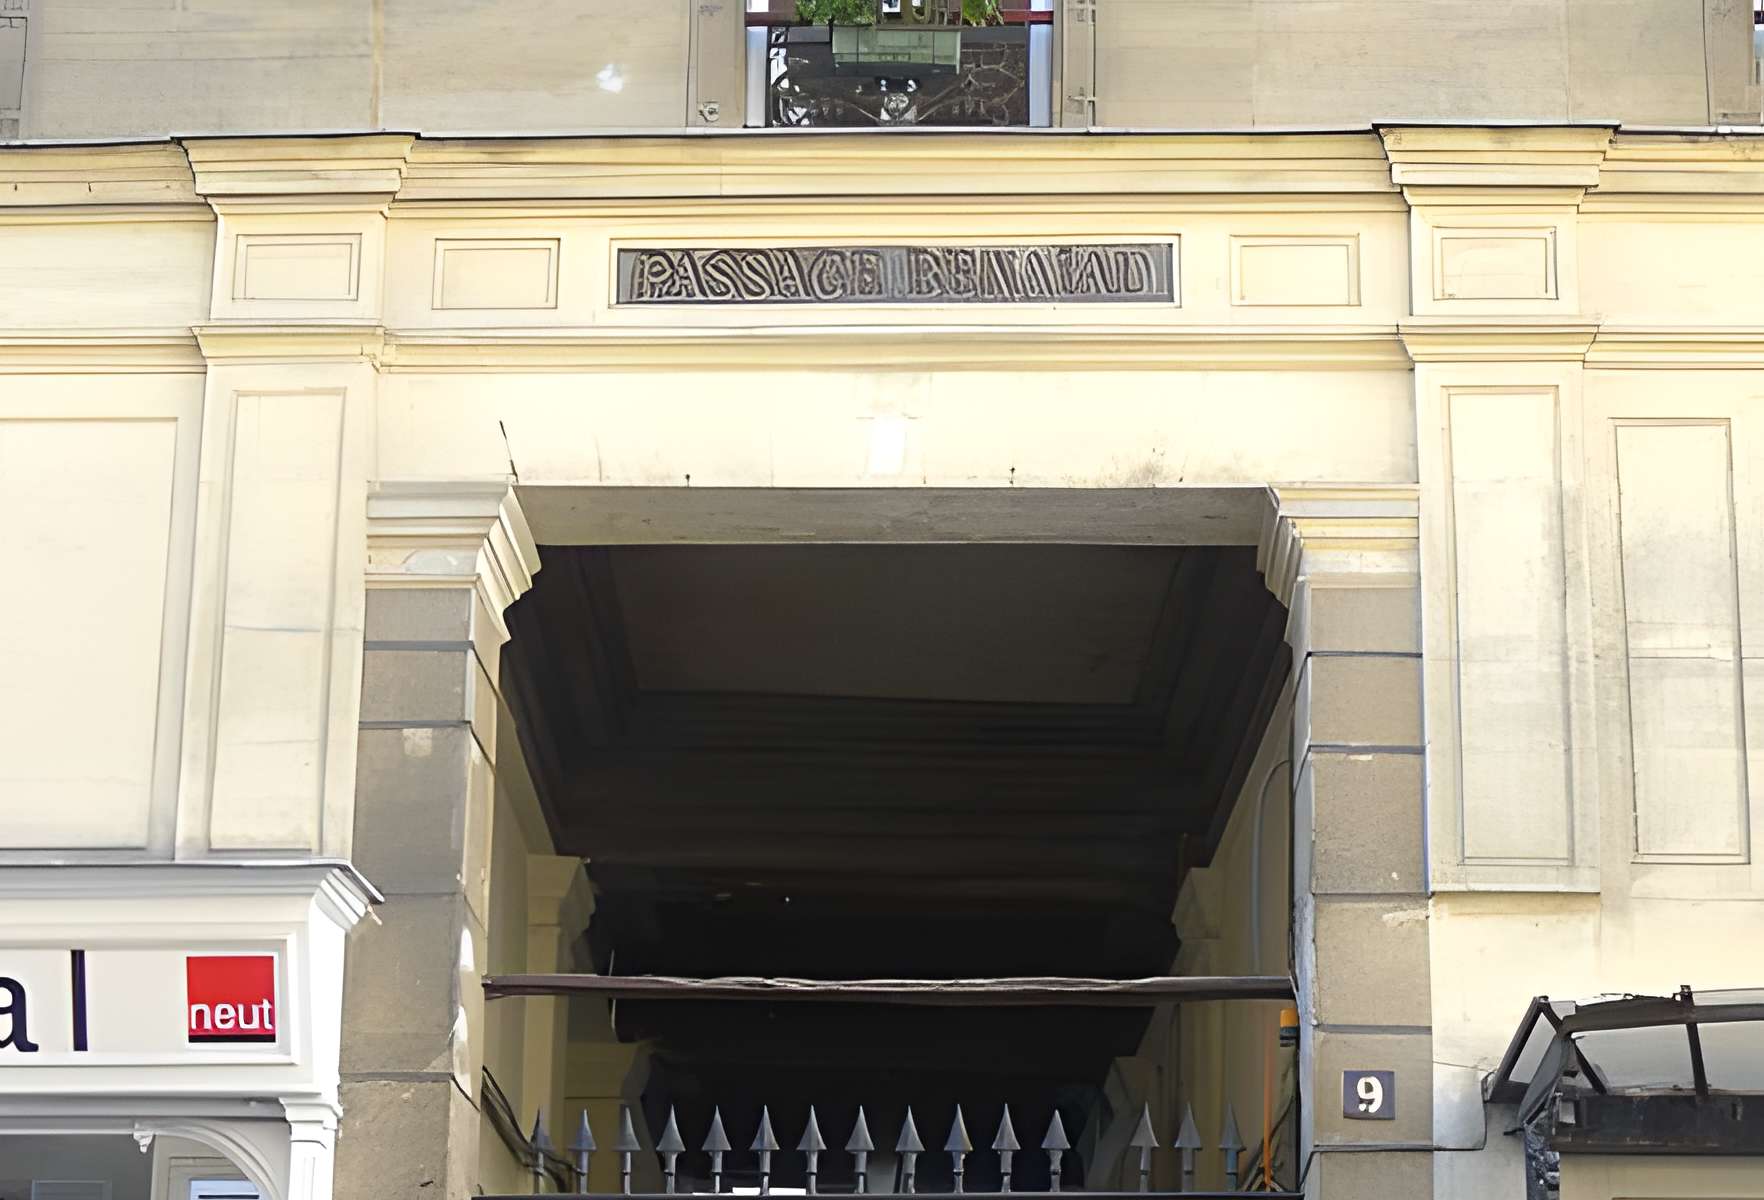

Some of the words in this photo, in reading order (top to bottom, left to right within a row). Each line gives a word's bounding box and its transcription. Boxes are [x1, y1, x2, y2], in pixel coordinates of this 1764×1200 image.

[634, 250, 886, 299] PASSAGE
[190, 998, 274, 1031] neut
[1356, 1075, 1384, 1114] 9
